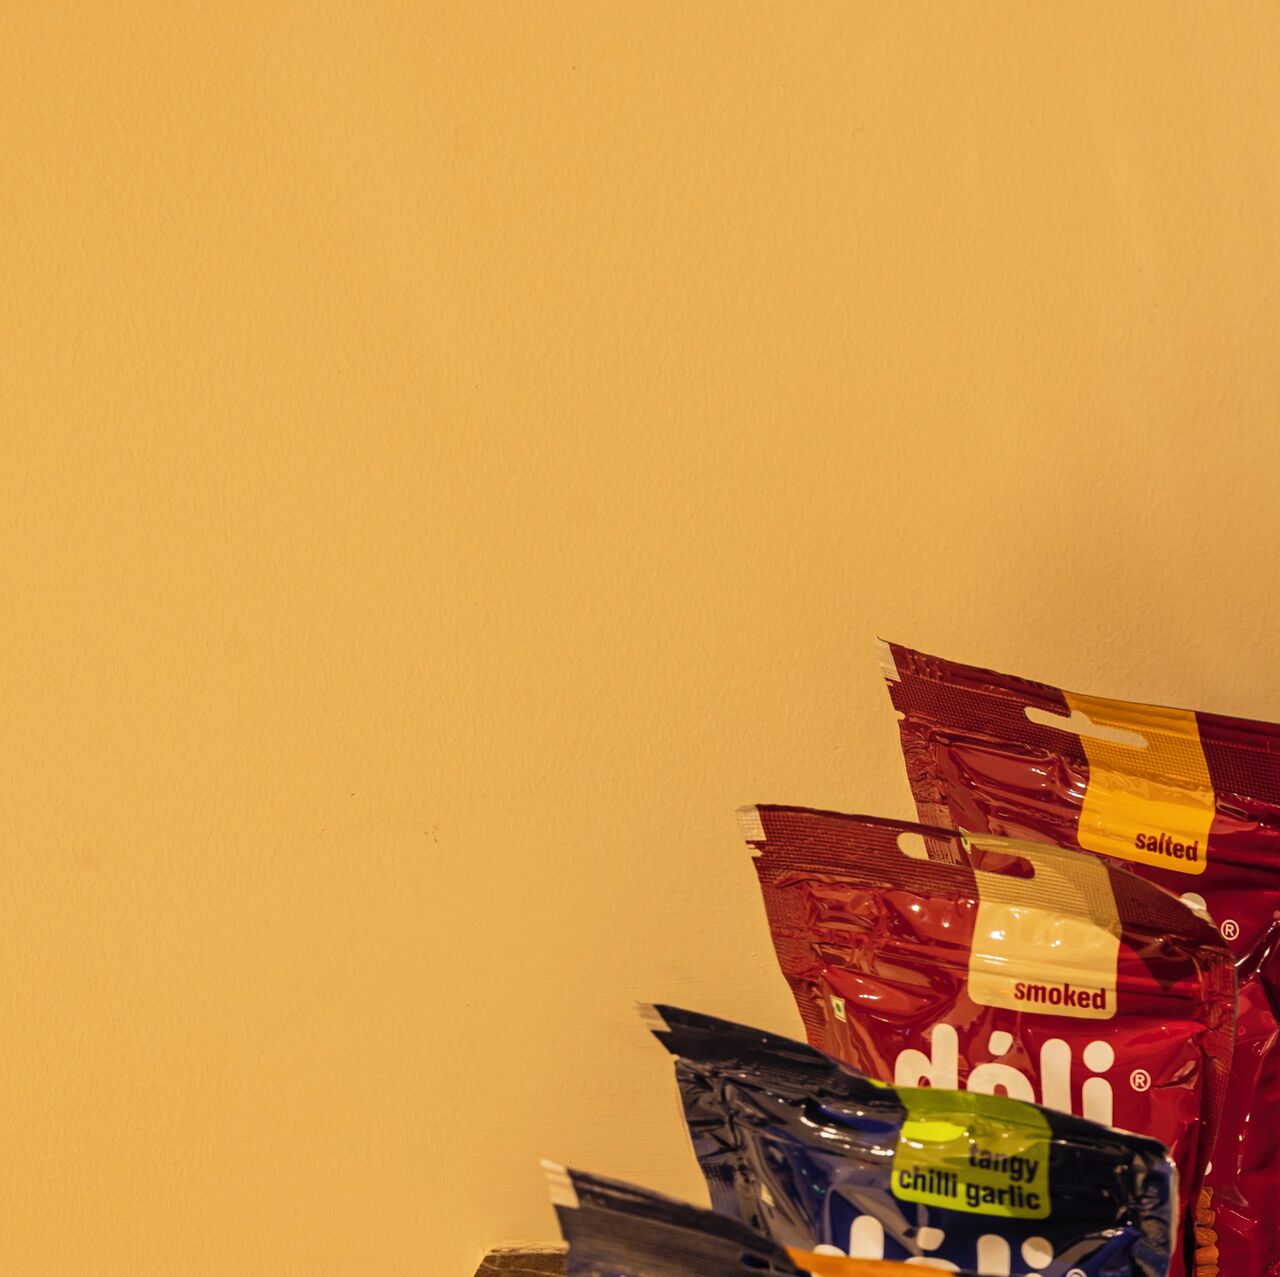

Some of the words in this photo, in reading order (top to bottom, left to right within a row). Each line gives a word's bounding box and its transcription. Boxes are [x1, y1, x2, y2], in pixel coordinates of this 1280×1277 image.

[1135, 831, 1199, 863] salted
[1014, 982, 1107, 1011] smoked
[969, 1143, 1039, 1184] tangy
[899, 1166, 958, 1198] chilli
[966, 1183, 1041, 1211] garlic
